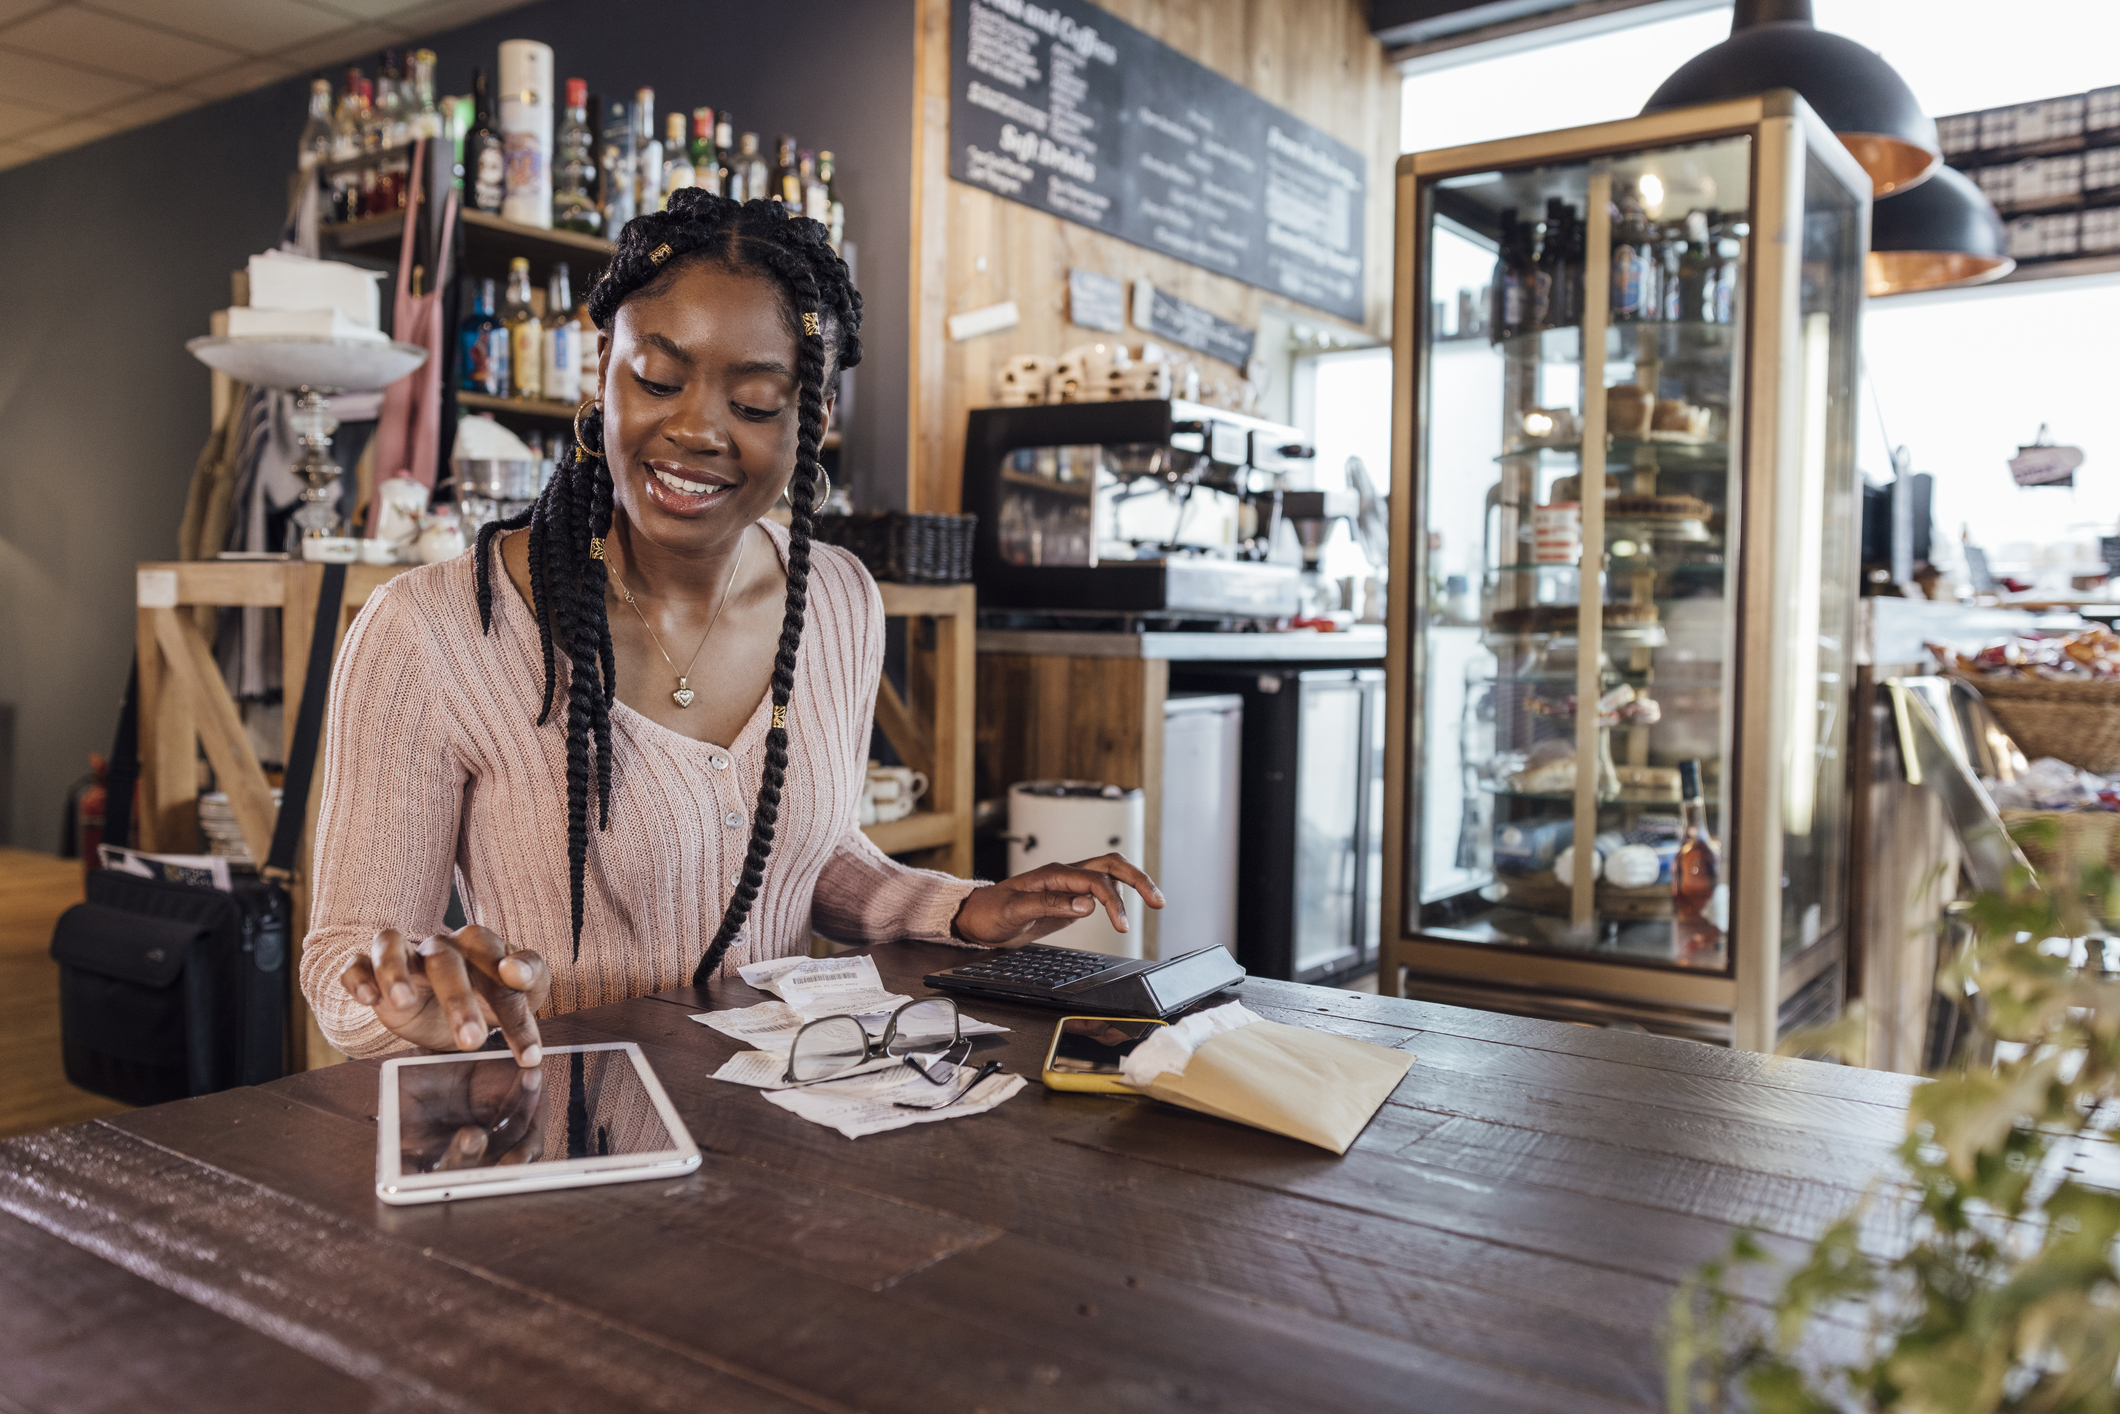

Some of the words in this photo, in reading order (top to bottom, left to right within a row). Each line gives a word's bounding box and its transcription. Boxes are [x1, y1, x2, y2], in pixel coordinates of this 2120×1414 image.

[1023, 3, 1060, 37] and
[999, 123, 1039, 163] Soft
[1037, 138, 1097, 184] Drinks
